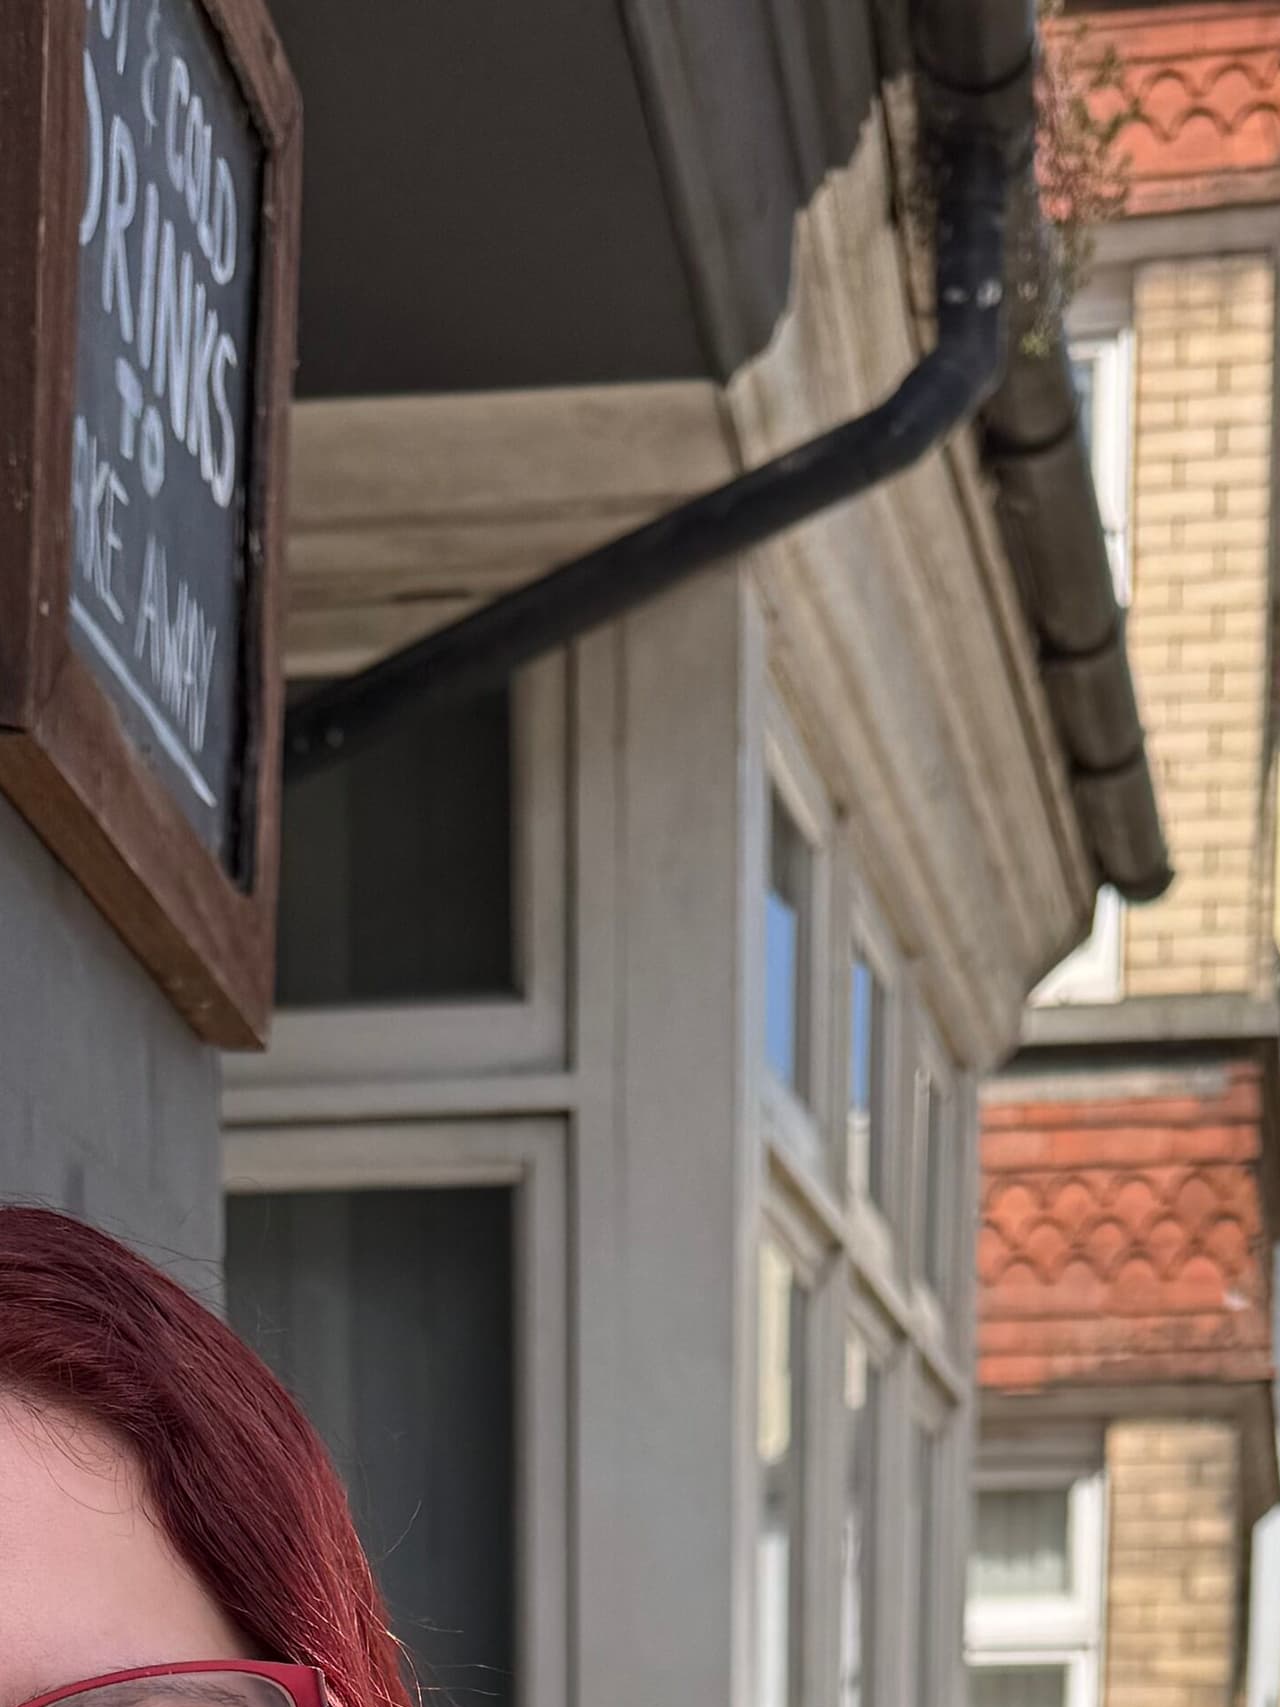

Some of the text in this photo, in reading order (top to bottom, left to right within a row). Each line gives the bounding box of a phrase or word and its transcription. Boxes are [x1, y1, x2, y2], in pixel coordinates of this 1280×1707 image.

[166, 56, 238, 285] COLD
[114, 355, 166, 499] TO
[71, 414, 217, 753] AKE AWAY
